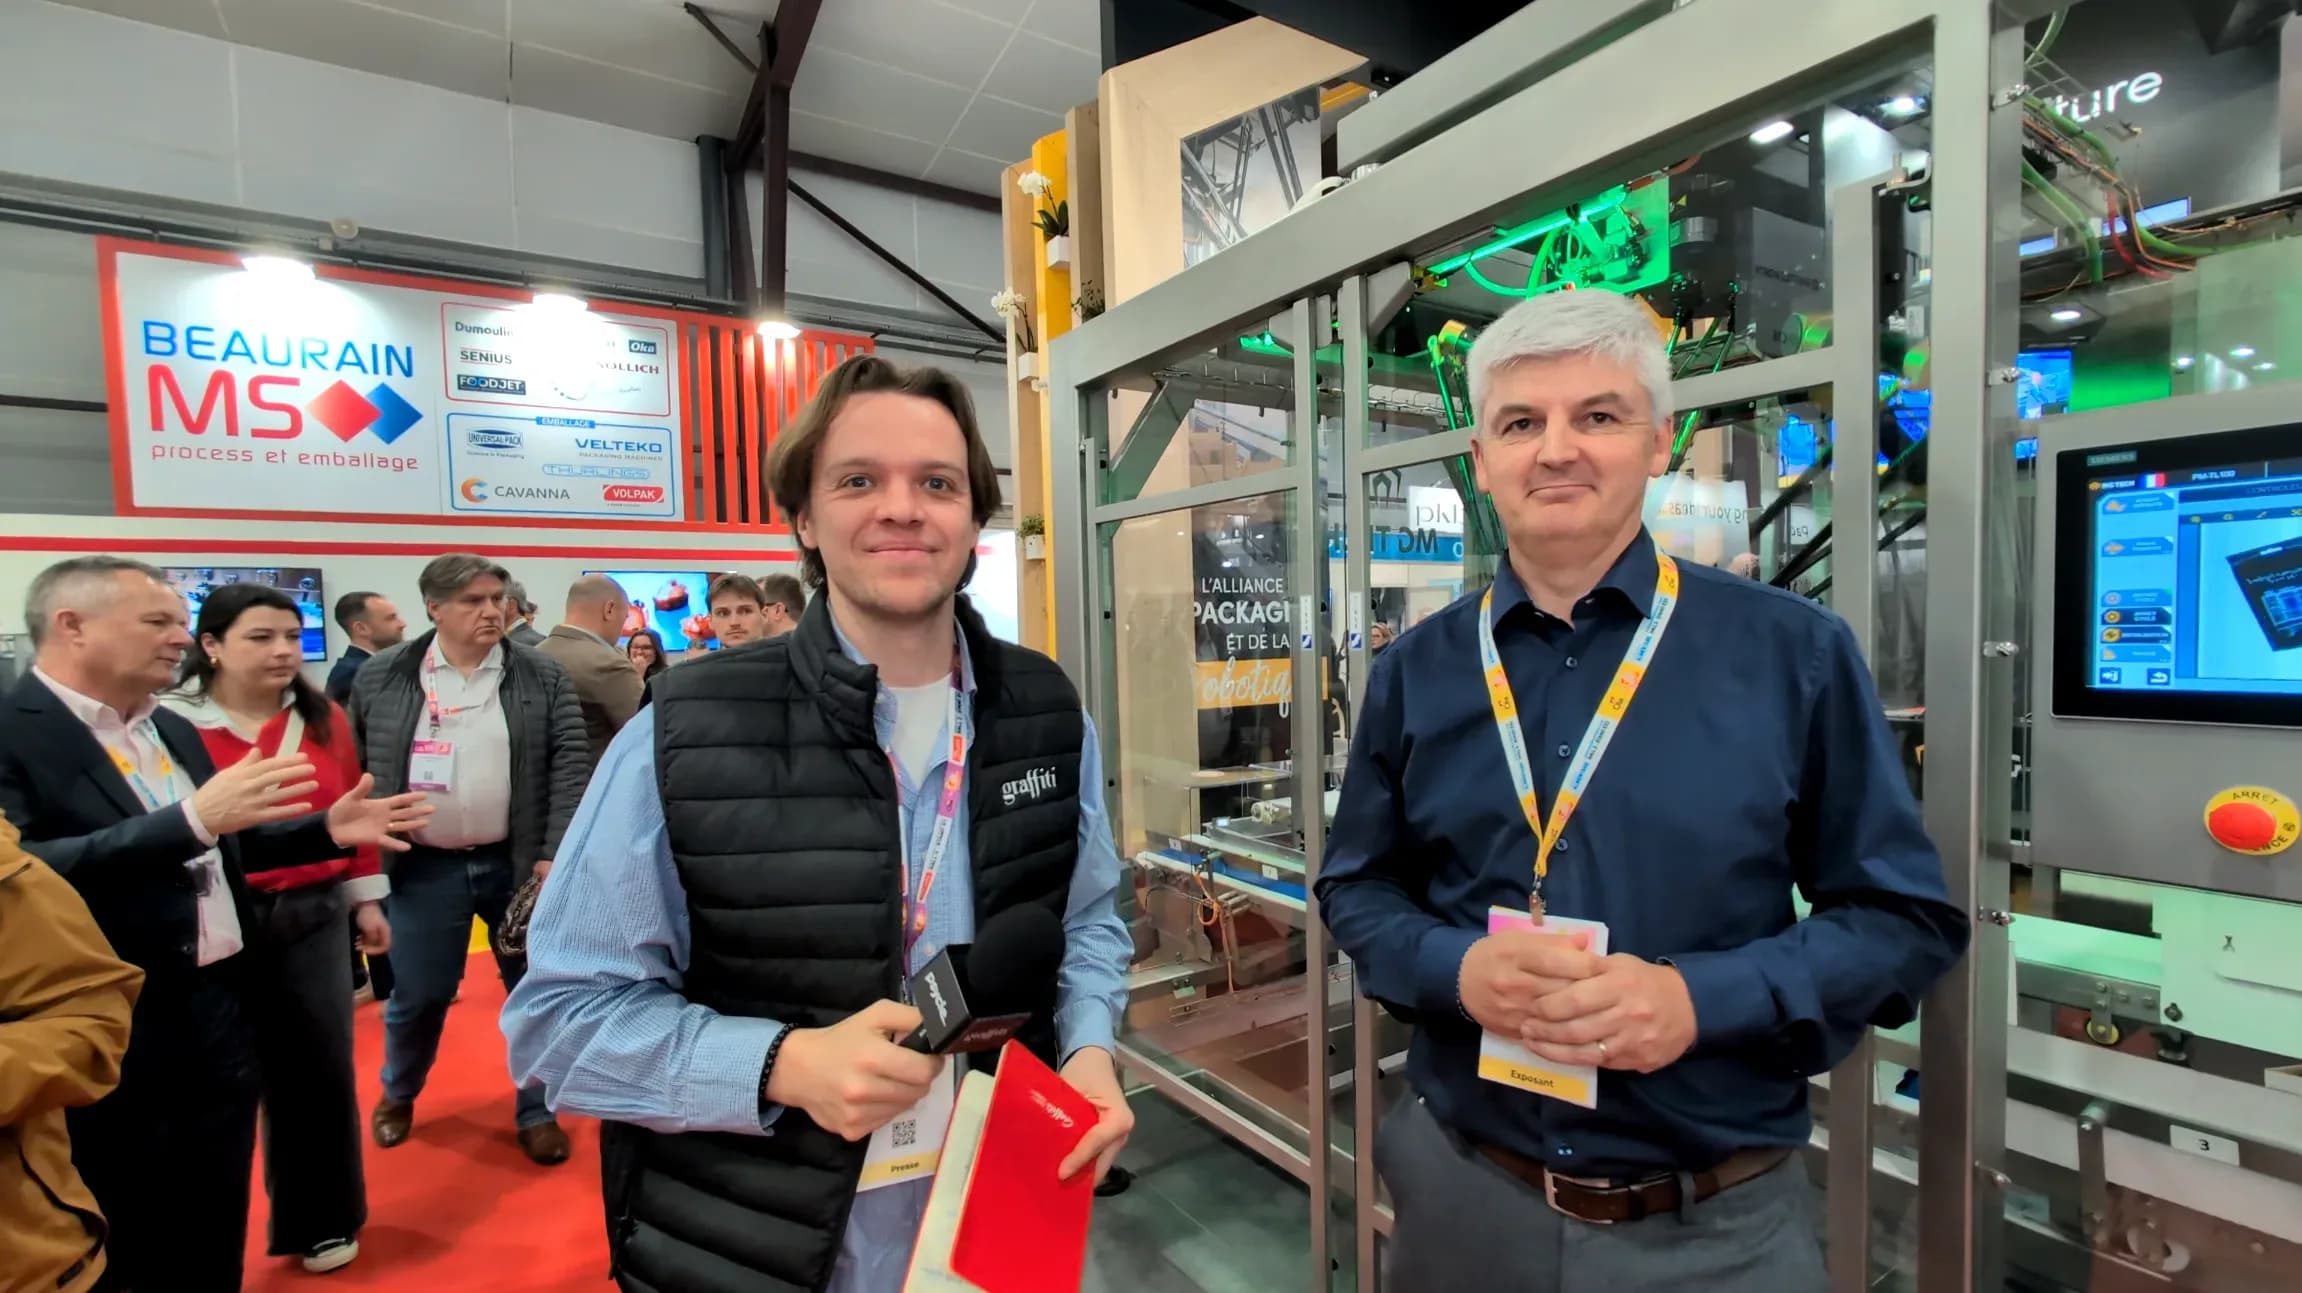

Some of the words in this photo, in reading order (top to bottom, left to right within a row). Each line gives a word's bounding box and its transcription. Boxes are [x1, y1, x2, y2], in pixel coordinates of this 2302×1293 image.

[2044, 71, 2163, 123] ture
[142, 320, 414, 378] BEAURAIN
[630, 342, 655, 353] Oka
[460, 350, 512, 364] SENIUS
[460, 376, 522, 391] FOODJET
[147, 363, 303, 440] MS
[541, 417, 591, 428] EMBALLAGE
[468, 431, 504, 444] UNIVERSAL
[575, 438, 663, 453] VELTEKO
[152, 445, 253, 463] process
[265, 449, 286, 464] et
[298, 452, 419, 472] emballage
[495, 486, 570, 500] CAVANNA
[612, 486, 656, 499] VOLPAK
[1249, 634, 1268, 649] DE
[1272, 633, 1290, 648] LA
[1002, 766, 1057, 806] graffiti
[1510, 1069, 1554, 1088] Exposant
[2199, 1139, 2210, 1151] 3
[891, 1162, 920, 1173] Presse
